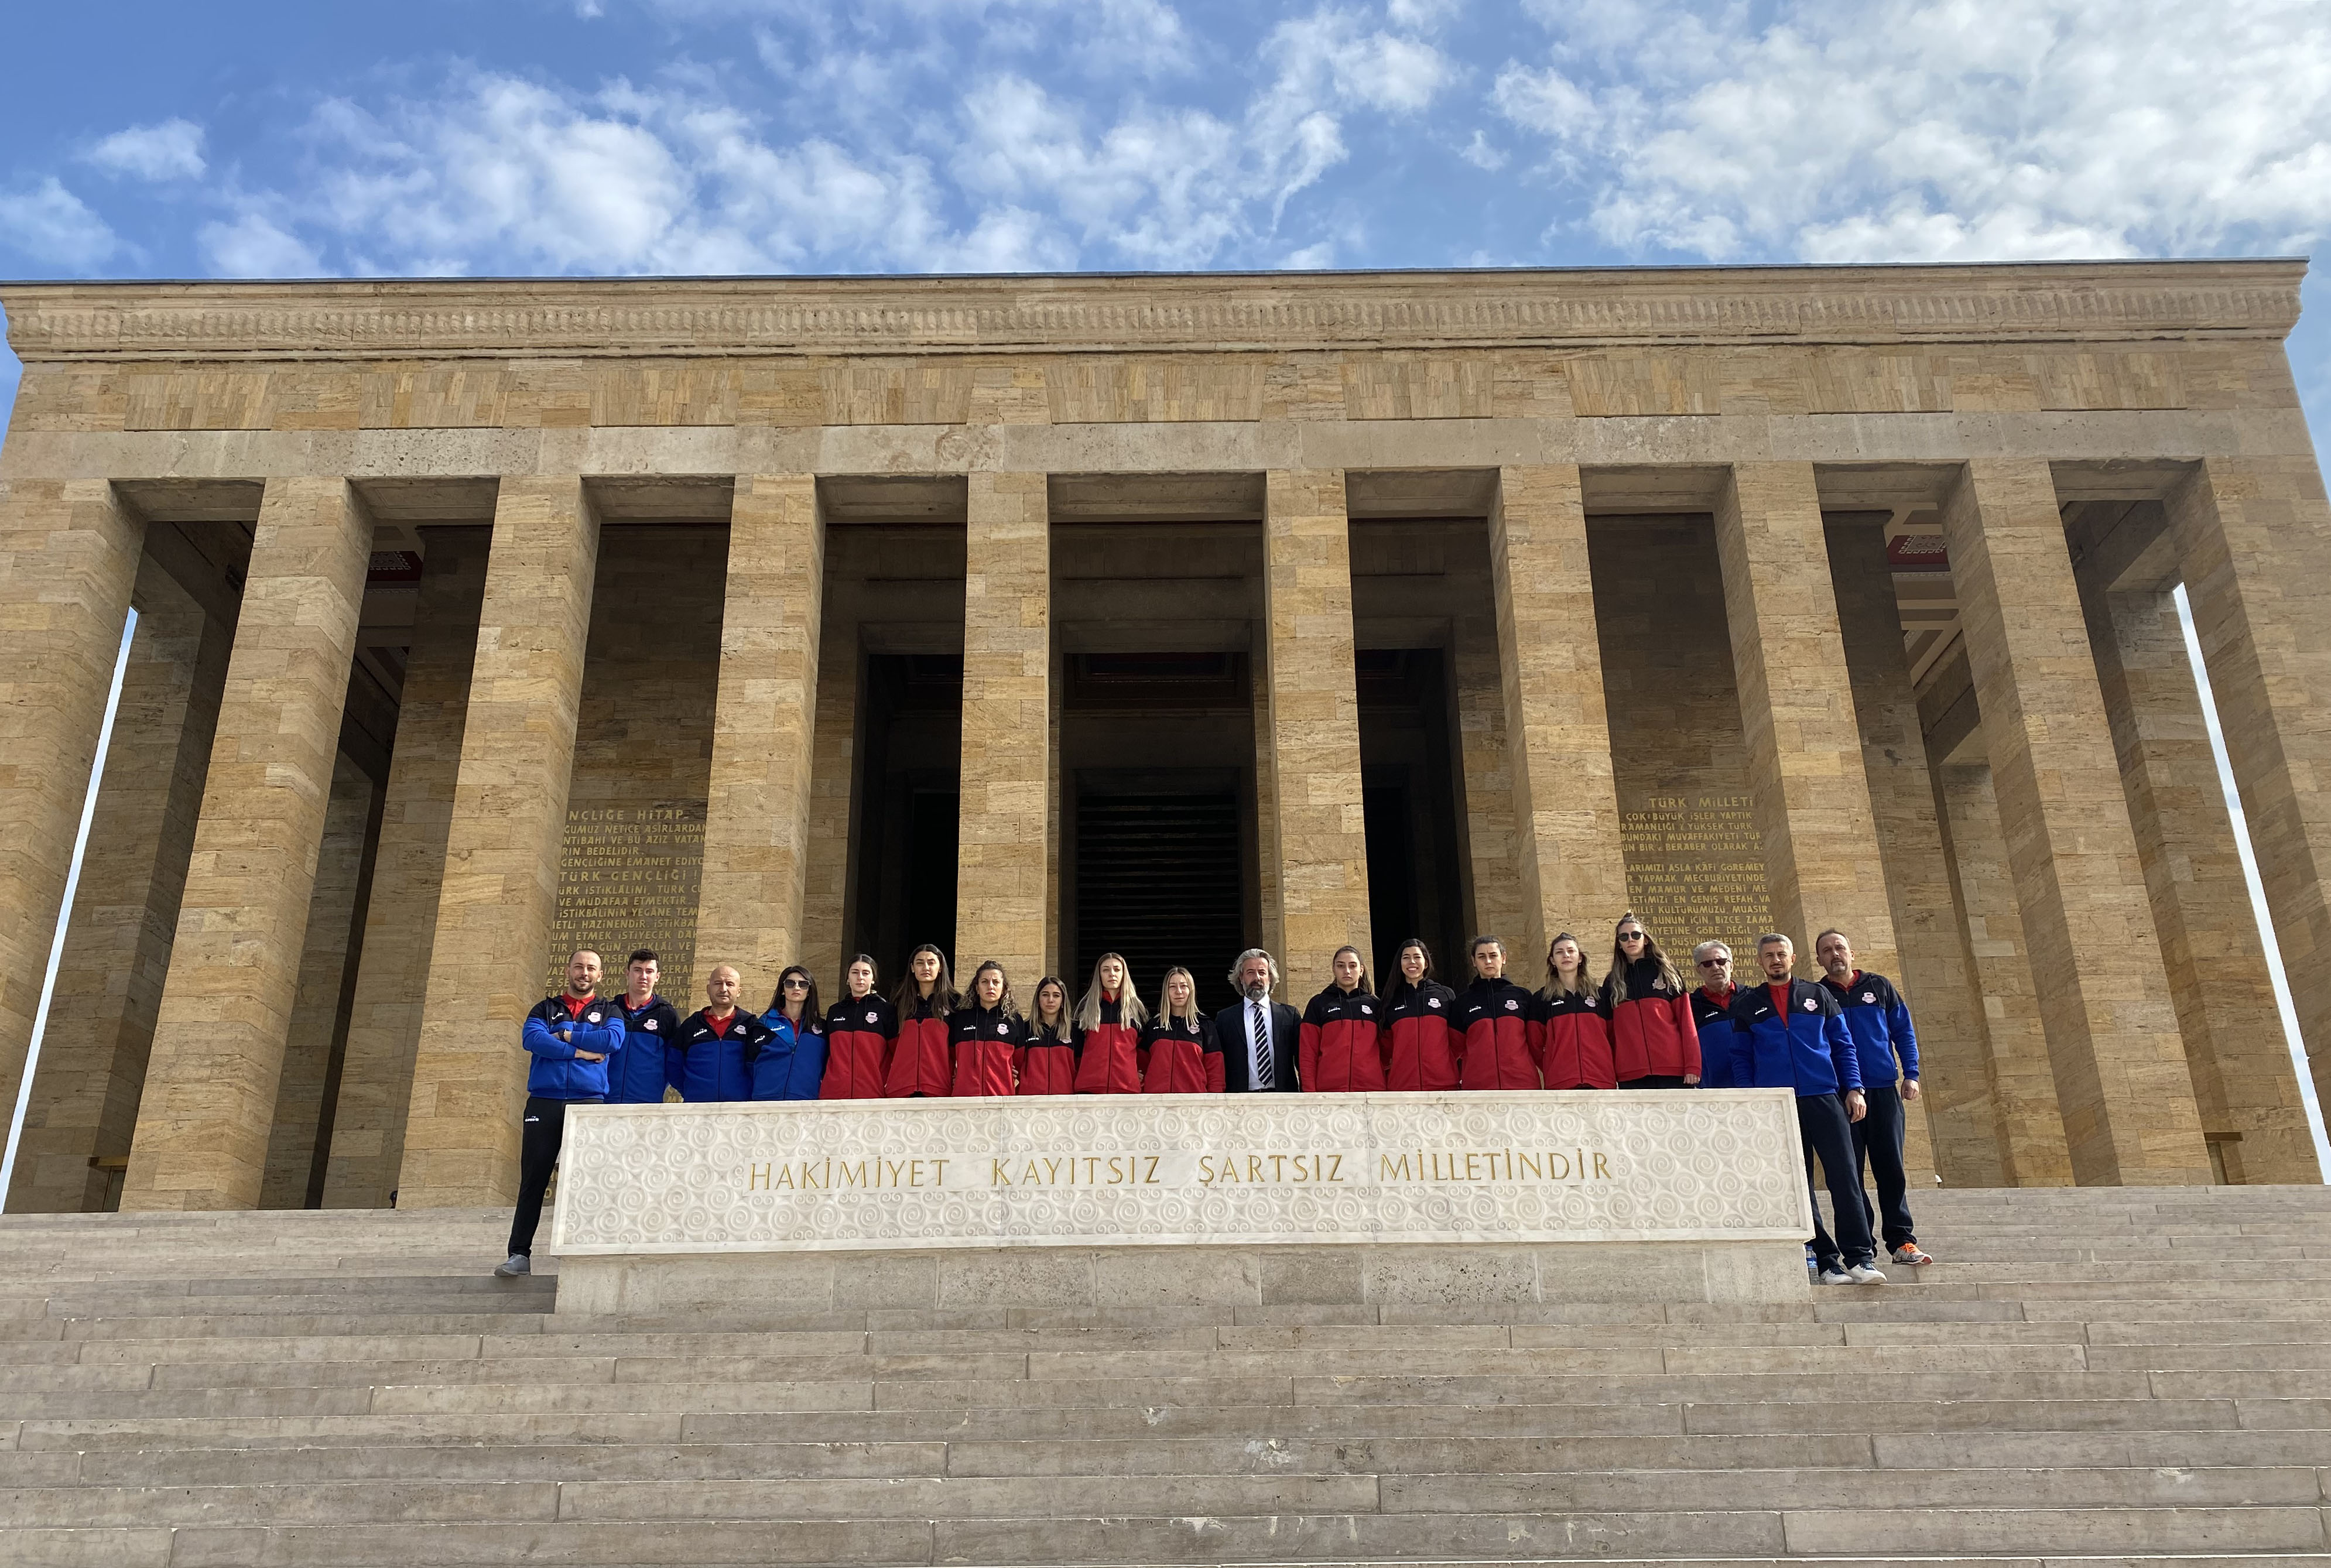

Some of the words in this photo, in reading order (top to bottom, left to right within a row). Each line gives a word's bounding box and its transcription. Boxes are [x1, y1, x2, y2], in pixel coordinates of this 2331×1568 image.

[1649, 797, 1686, 808] TÜRK
[1699, 797, 1753, 807] MİLLETİ
[1626, 813, 1647, 821] ÇOK
[1652, 812, 1685, 820] BÜYÜK
[1720, 812, 1752, 820] YAPTIK
[611, 836, 624, 844] VE
[627, 836, 640, 844] BU
[1665, 843, 1706, 851] BERABER
[627, 857, 671, 866] EMANET
[560, 871, 600, 882] TÜRK
[657, 885, 685, 893] TÜRK
[1629, 885, 1642, 893] EN
[1648, 885, 1686, 893] MAMUR
[559, 898, 571, 906] VE
[576, 897, 628, 906] MÜDAFAA
[1691, 895, 1718, 905] GENİŞ
[1759, 895, 1771, 903] VA
[676, 908, 698, 916] TEM
[1732, 905, 1768, 913] MUASIR
[1715, 916, 1741, 924] BİZCE
[1696, 926, 1721, 934] GÖRE
[576, 931, 611, 940] ETMEK
[679, 942, 691, 950] VE
[1668, 948, 1693, 956] DAHA
[749, 1156, 950, 1191] HAKİMİYET
[992, 1156, 1161, 1187] KAYITSIZ
[1197, 1153, 1344, 1188] ŞARTSIZ
[1380, 1147, 1613, 1182] MİLLETİNDİR
